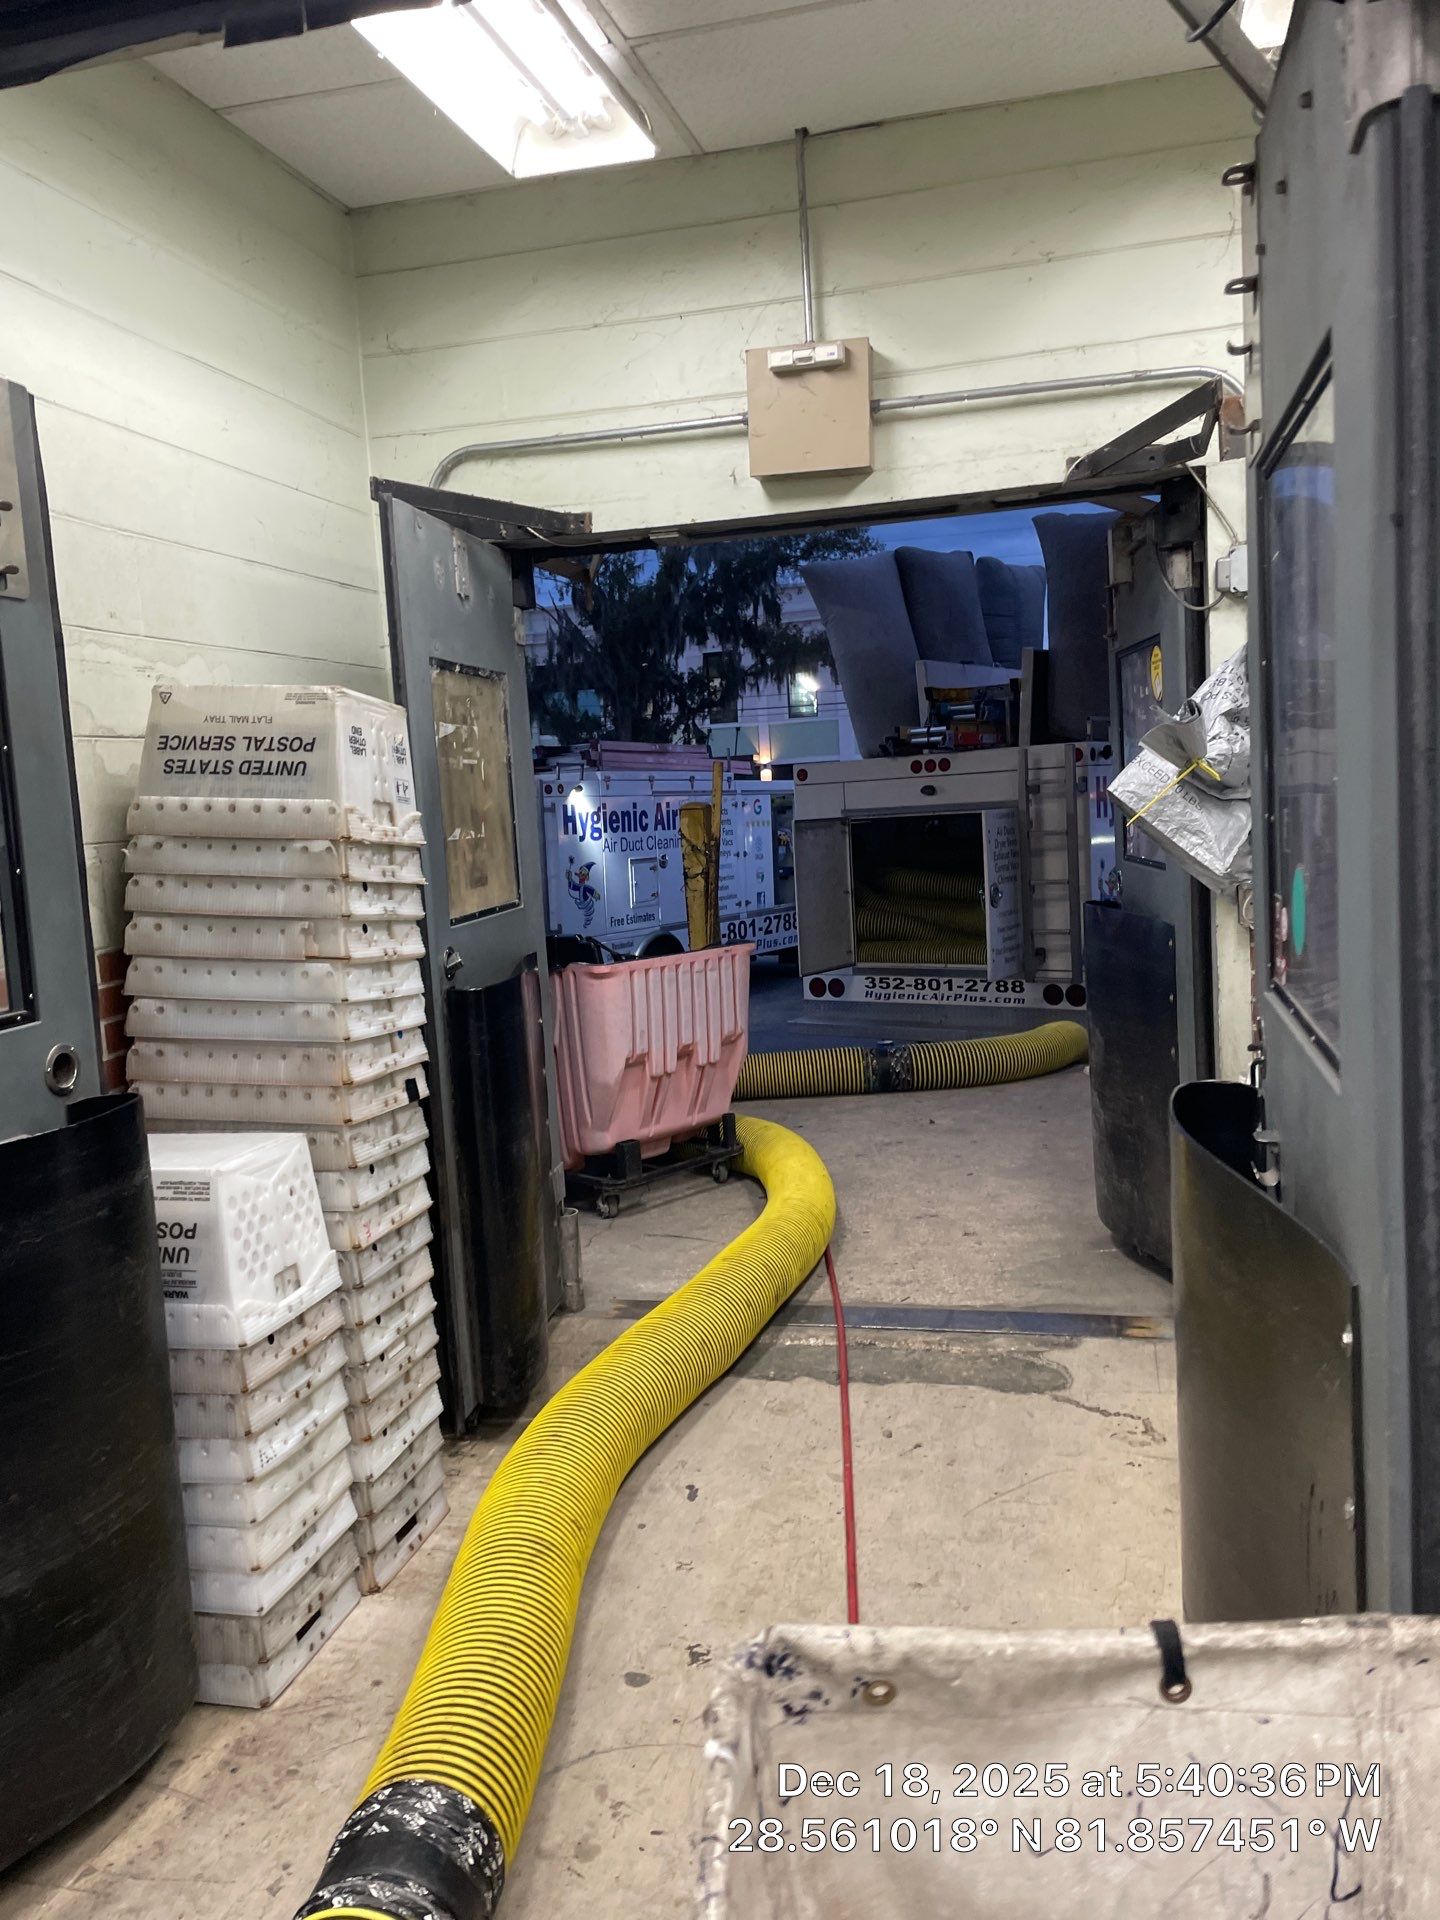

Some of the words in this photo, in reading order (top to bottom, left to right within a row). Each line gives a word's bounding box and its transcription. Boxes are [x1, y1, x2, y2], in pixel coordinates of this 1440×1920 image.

[203, 715, 226, 724] TRAY
[229, 715, 249, 724] MAIL
[251, 715, 273, 724] FLAT
[351, 725, 363, 736] END
[157, 735, 237, 751] SERVICE
[243, 736, 317, 753] POSTAL
[349, 735, 367, 747] OTHER
[349, 745, 367, 757] LABEL
[163, 758, 235, 775] STATES
[238, 759, 308, 776] UNITED
[562, 802, 649, 842] Hygienic
[653, 802, 679, 831] Air
[722, 827, 734, 836] Fans
[603, 838, 618, 853] Air
[620, 836, 644, 852] Duct
[646, 834, 684, 851] Cleanin
[722, 838, 734, 846] Vacs
[610, 916, 625, 928] Free
[625, 912, 656, 925] Estimates
[864, 976, 1026, 994] 352-801-2788
[864, 990, 1026, 1005] HygienicAirPlus.com
